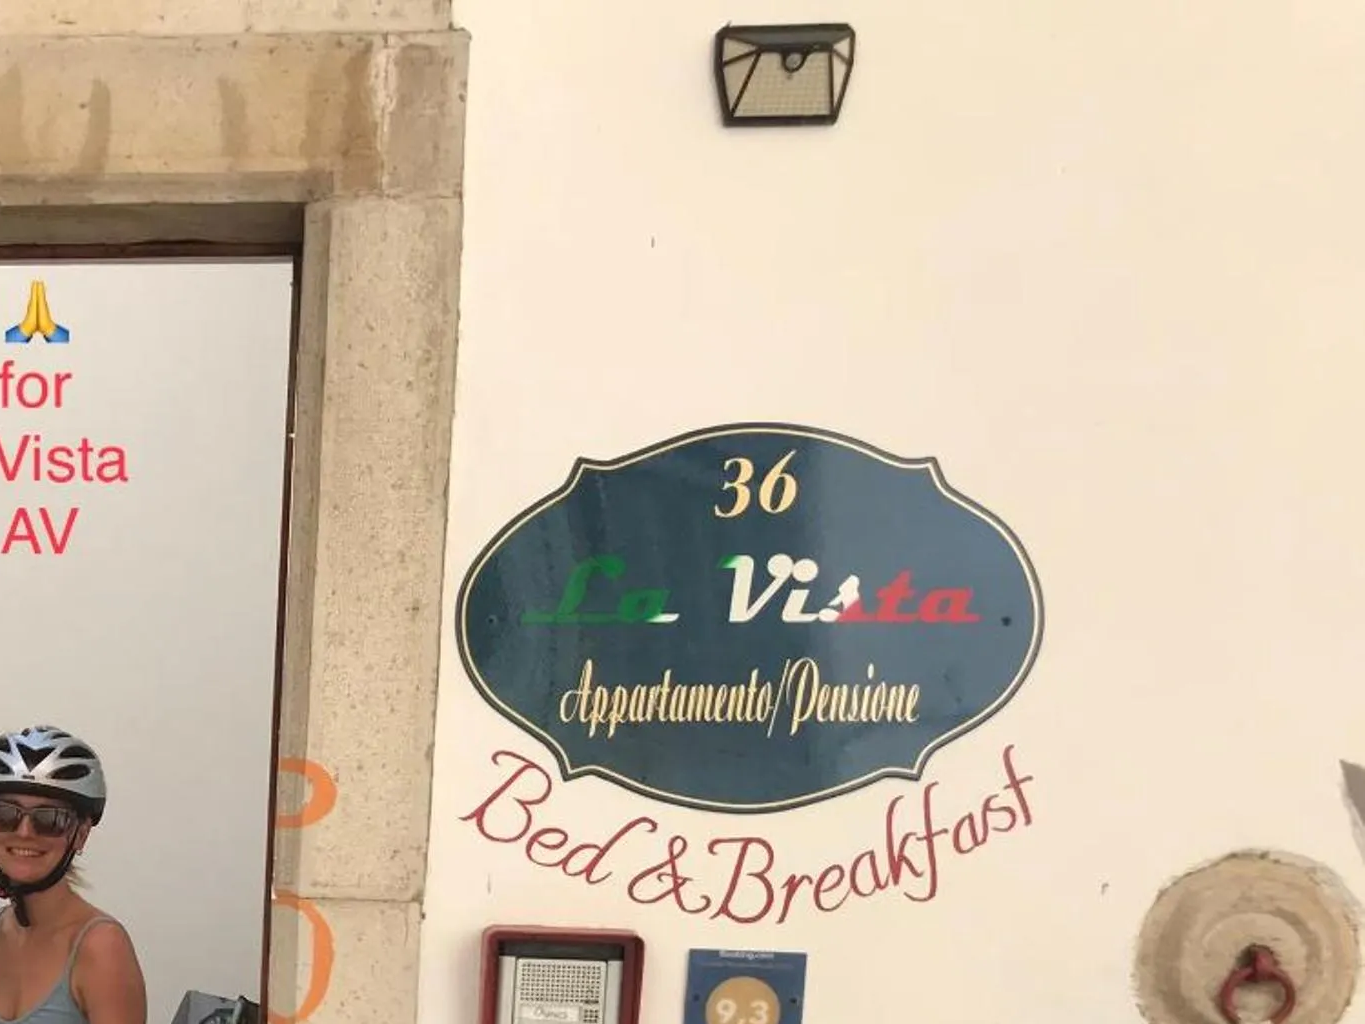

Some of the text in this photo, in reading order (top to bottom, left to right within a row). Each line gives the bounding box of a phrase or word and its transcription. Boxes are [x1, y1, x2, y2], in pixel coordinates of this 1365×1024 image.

[714, 449, 800, 519] 36
[519, 552, 983, 624] La Vista
[459, 743, 1035, 925] Bed & Breakfast
